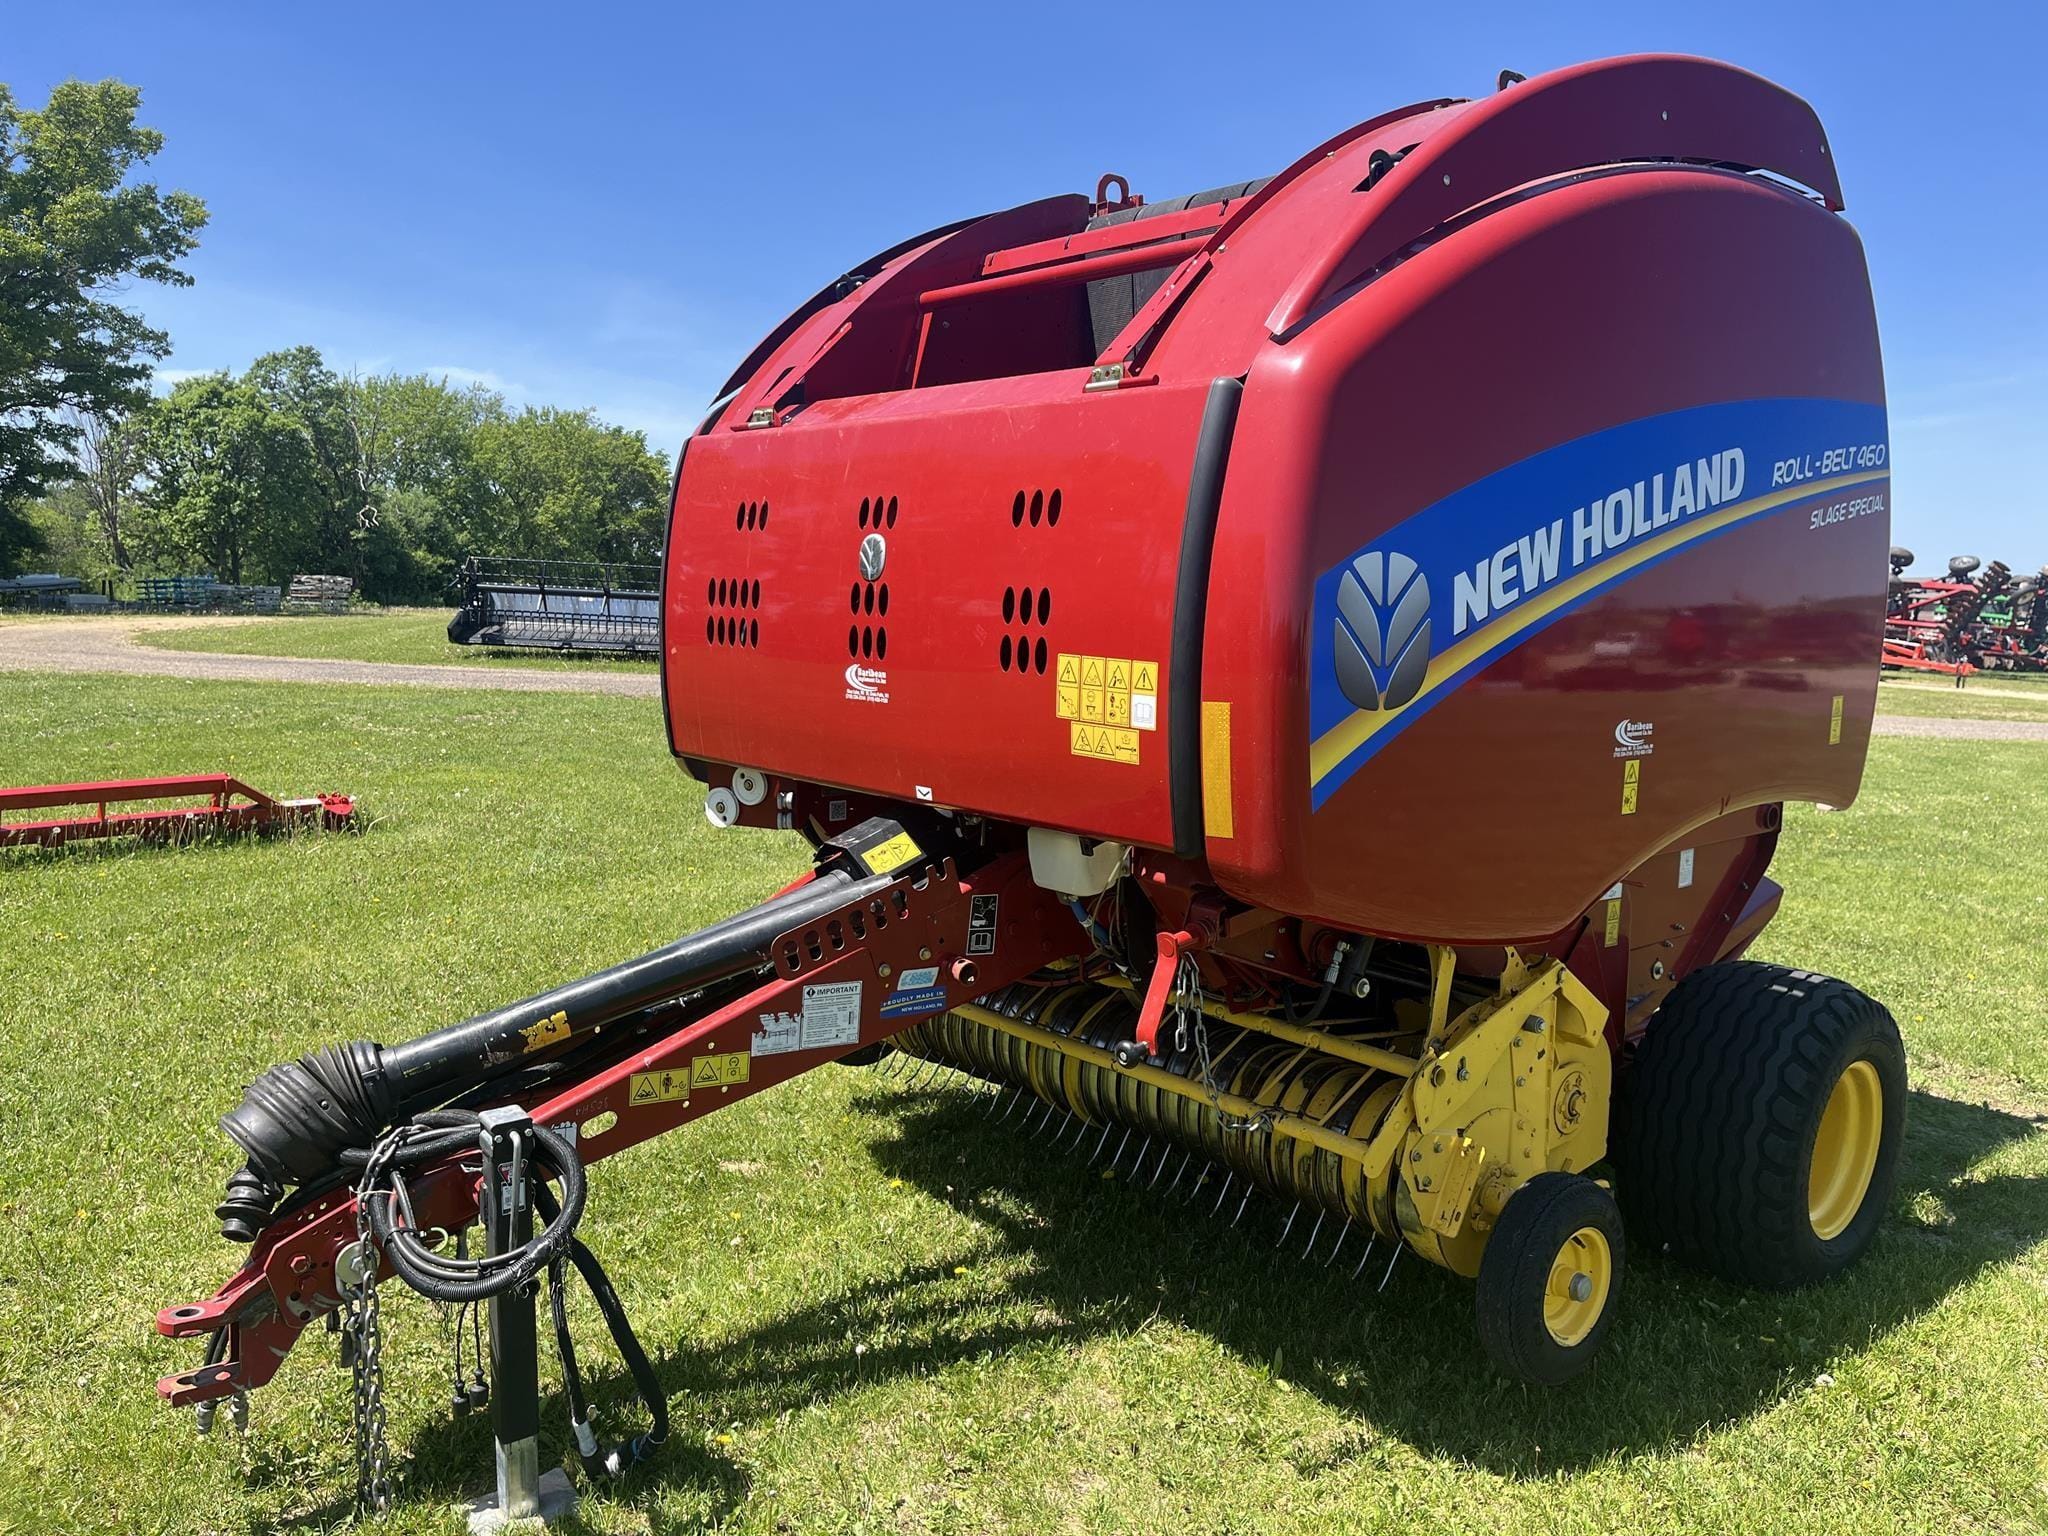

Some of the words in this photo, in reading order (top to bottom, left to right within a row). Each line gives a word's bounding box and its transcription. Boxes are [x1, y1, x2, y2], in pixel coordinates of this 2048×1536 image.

[1857, 443, 1886, 468] 460
[1809, 502, 1847, 530] SILAGE
[1847, 494, 1885, 519] SPECIAL
[1453, 518, 1564, 637] NEW
[1572, 447, 1745, 568] HOLLAND
[816, 985, 858, 996] IMPORTANT
[883, 995, 914, 1006] PROUDLY
[916, 992, 934, 1000] MADE
